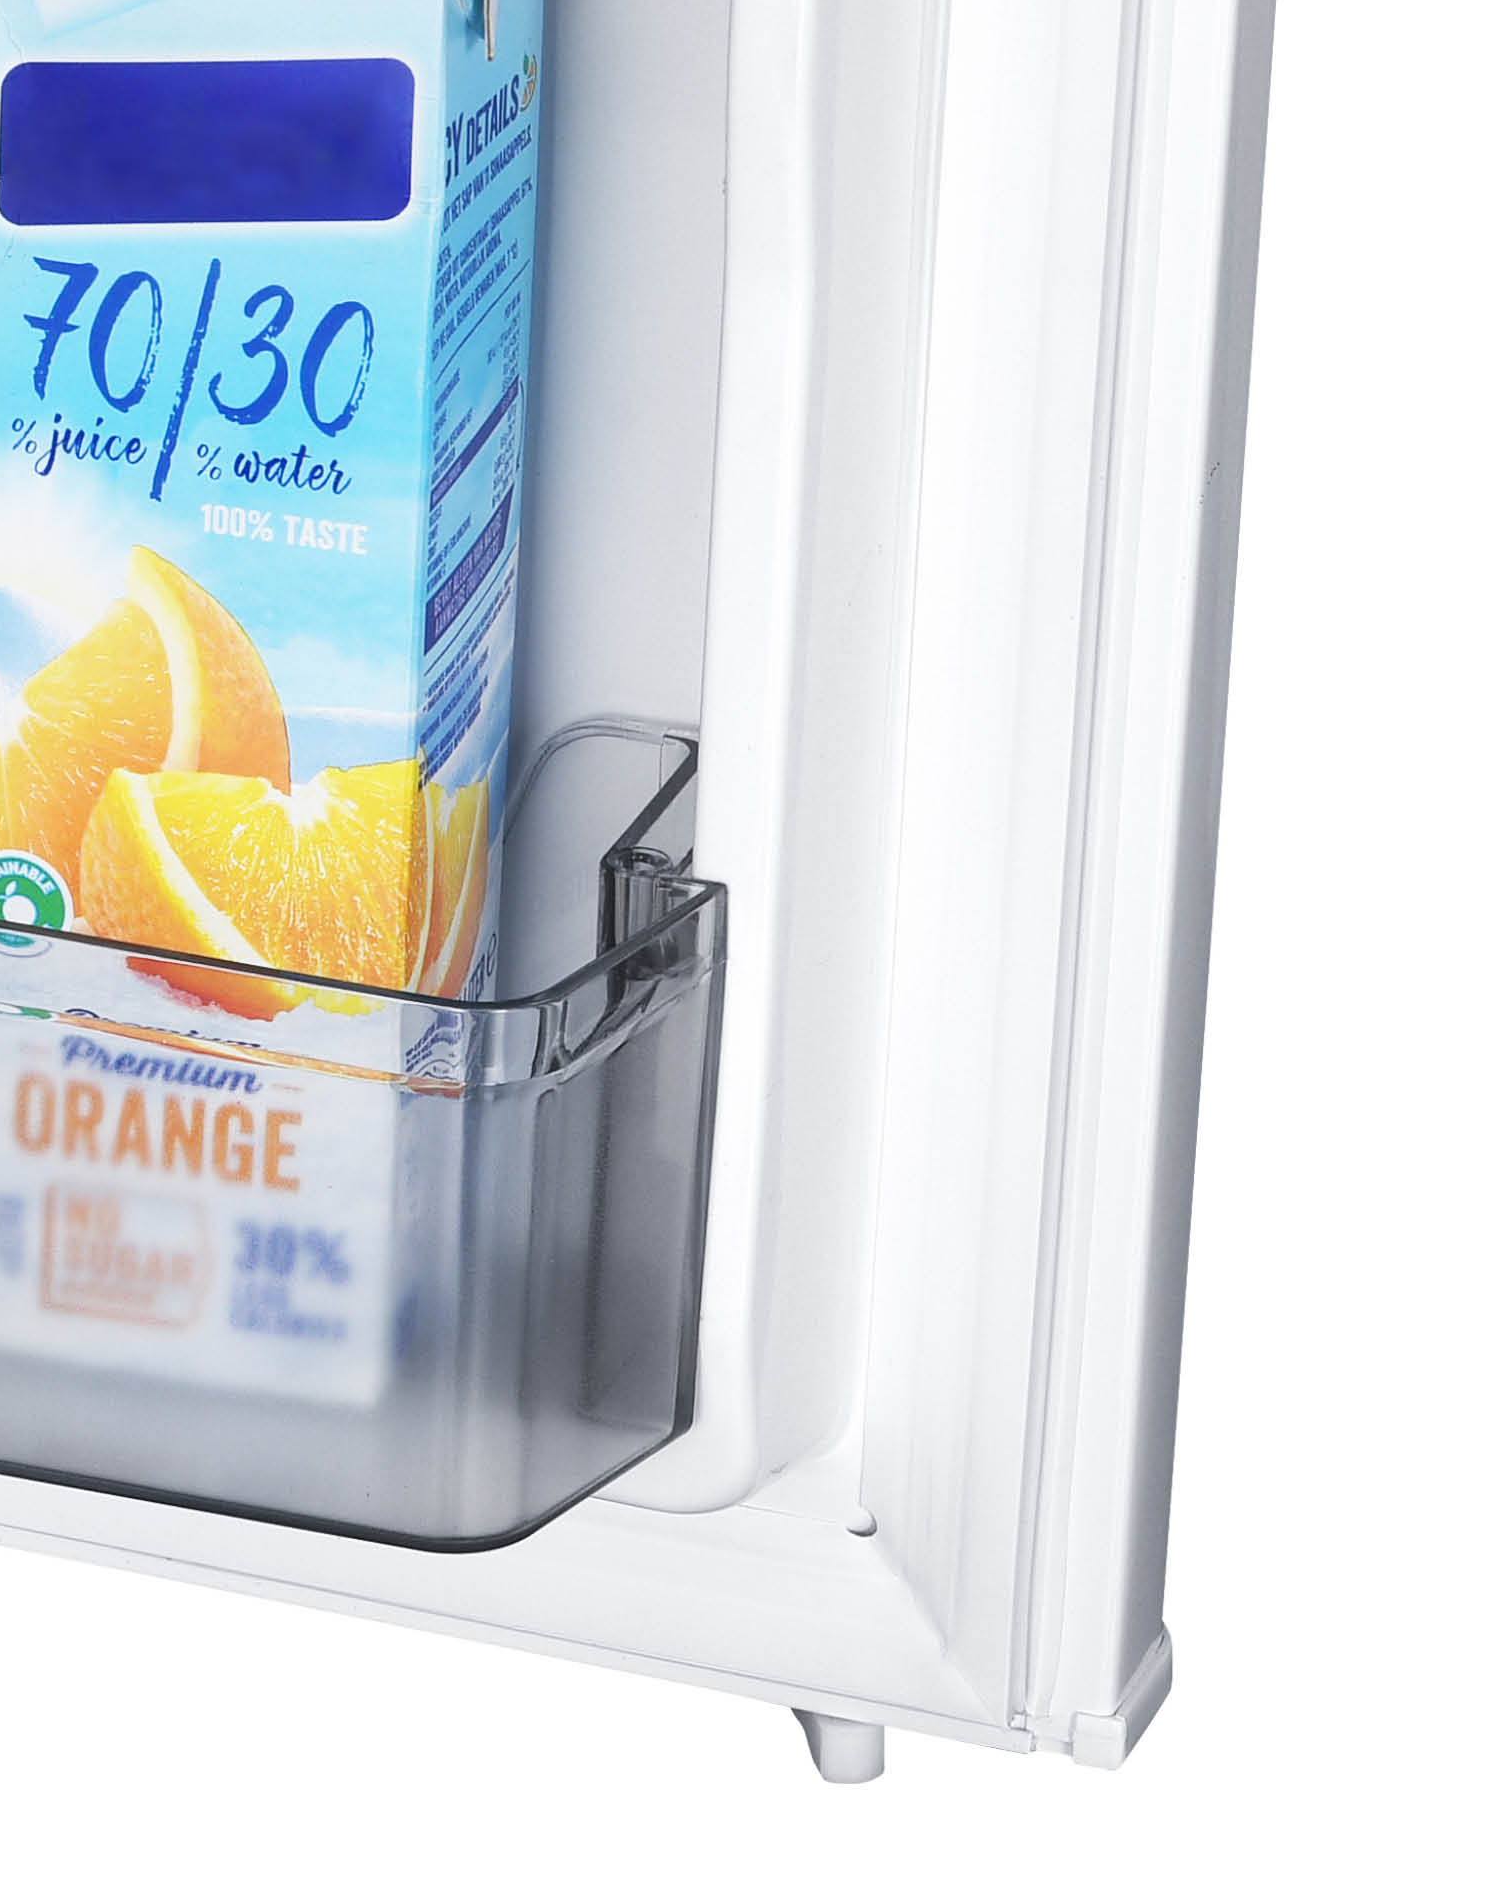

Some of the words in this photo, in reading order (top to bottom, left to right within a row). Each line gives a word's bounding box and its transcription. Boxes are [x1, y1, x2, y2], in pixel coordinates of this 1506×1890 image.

[465, 73, 520, 166] DETAILS
[11, 417, 38, 455] %
[34, 412, 148, 477] juice
[196, 443, 222, 481] %
[233, 443, 354, 495] water
[199, 503, 275, 543] 100%
[283, 514, 370, 556] TASTE
[60, 1032, 264, 1095] Premium
[12, 1069, 305, 1192] ORANGE
